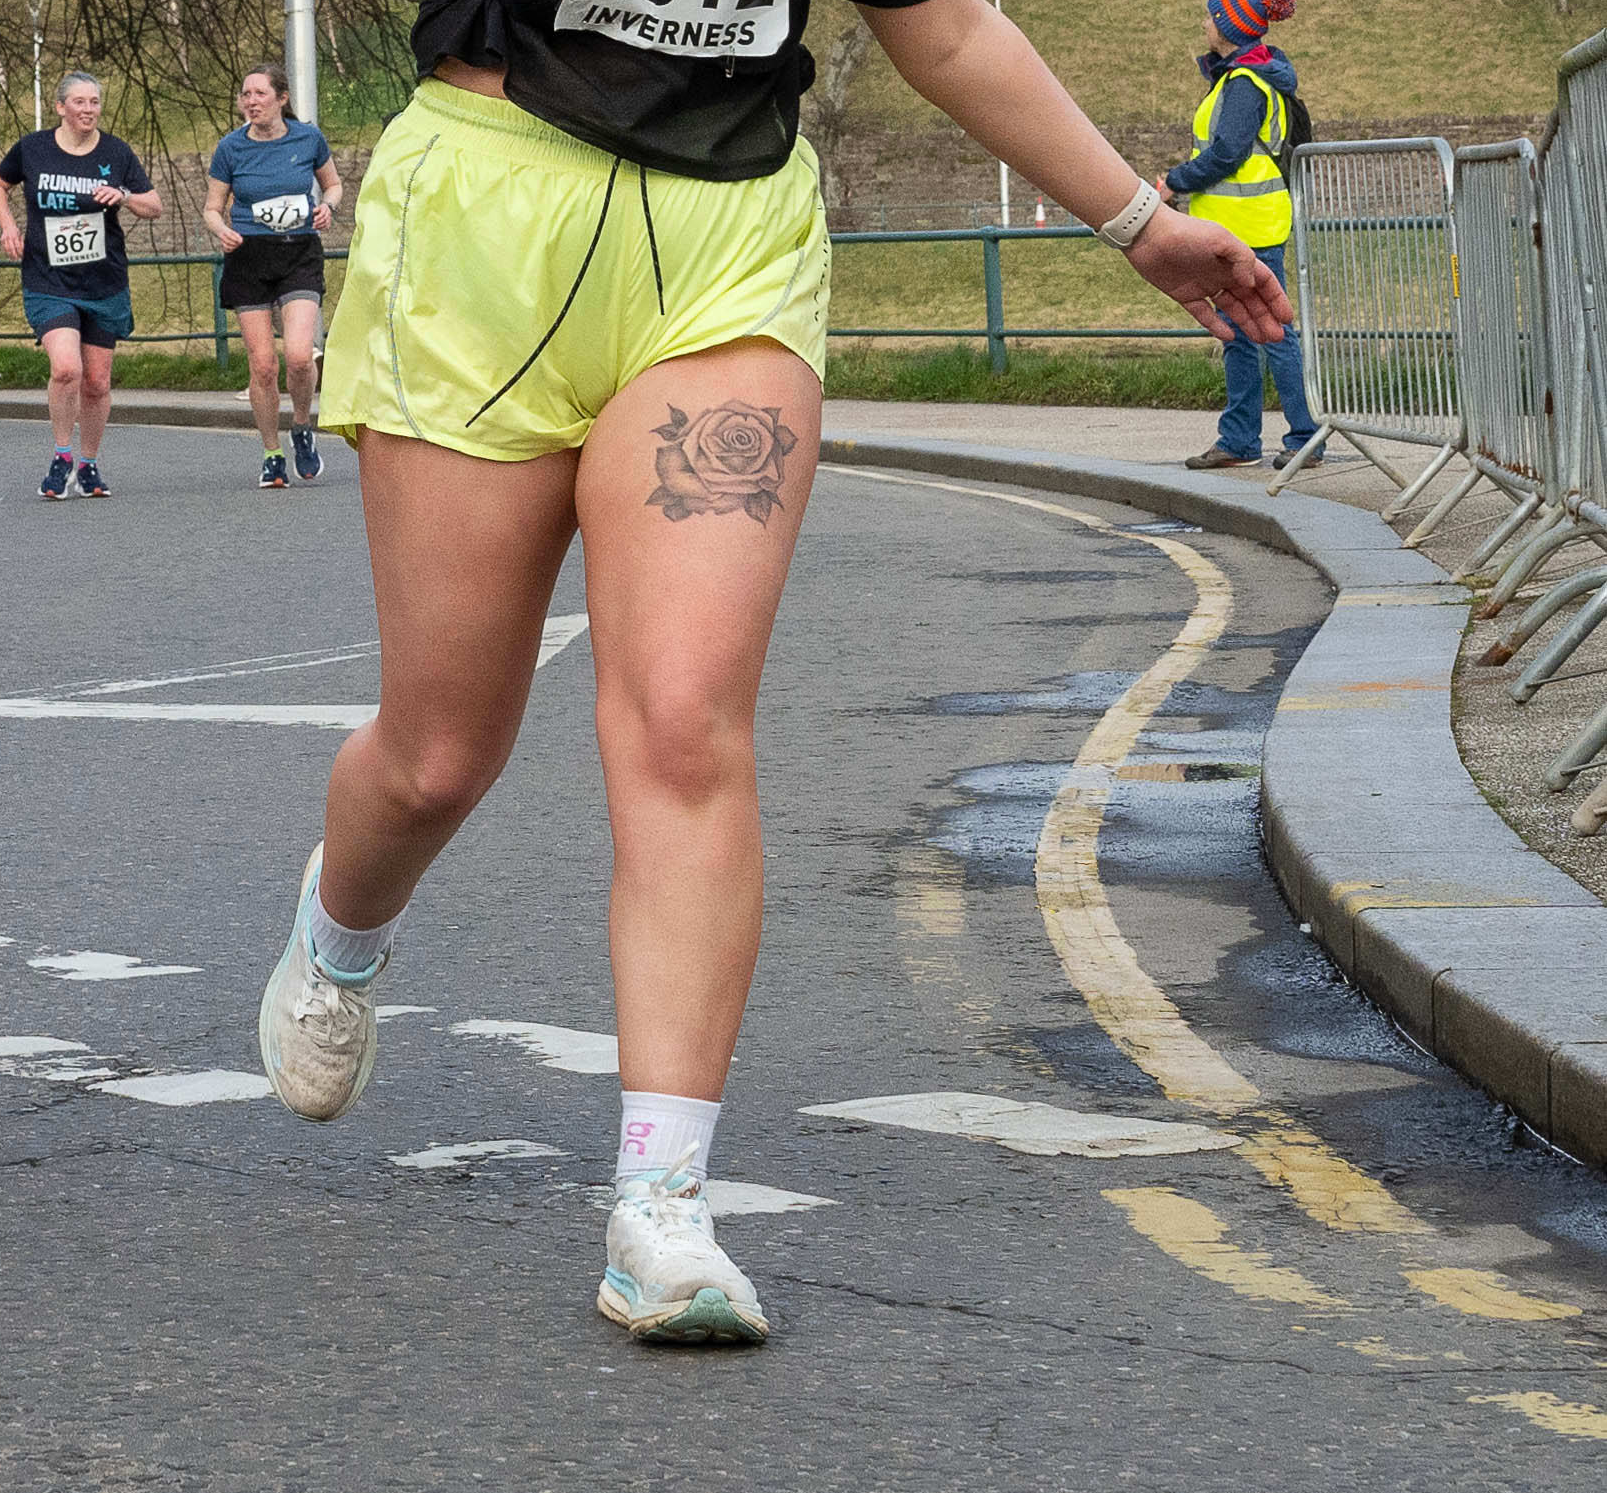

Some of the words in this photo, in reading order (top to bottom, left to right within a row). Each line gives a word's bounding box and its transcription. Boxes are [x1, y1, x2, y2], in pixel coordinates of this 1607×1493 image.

[582, 4, 756, 48] INVERNESS
[37, 192, 80, 211] LATE.
[54, 230, 98, 255] 867
